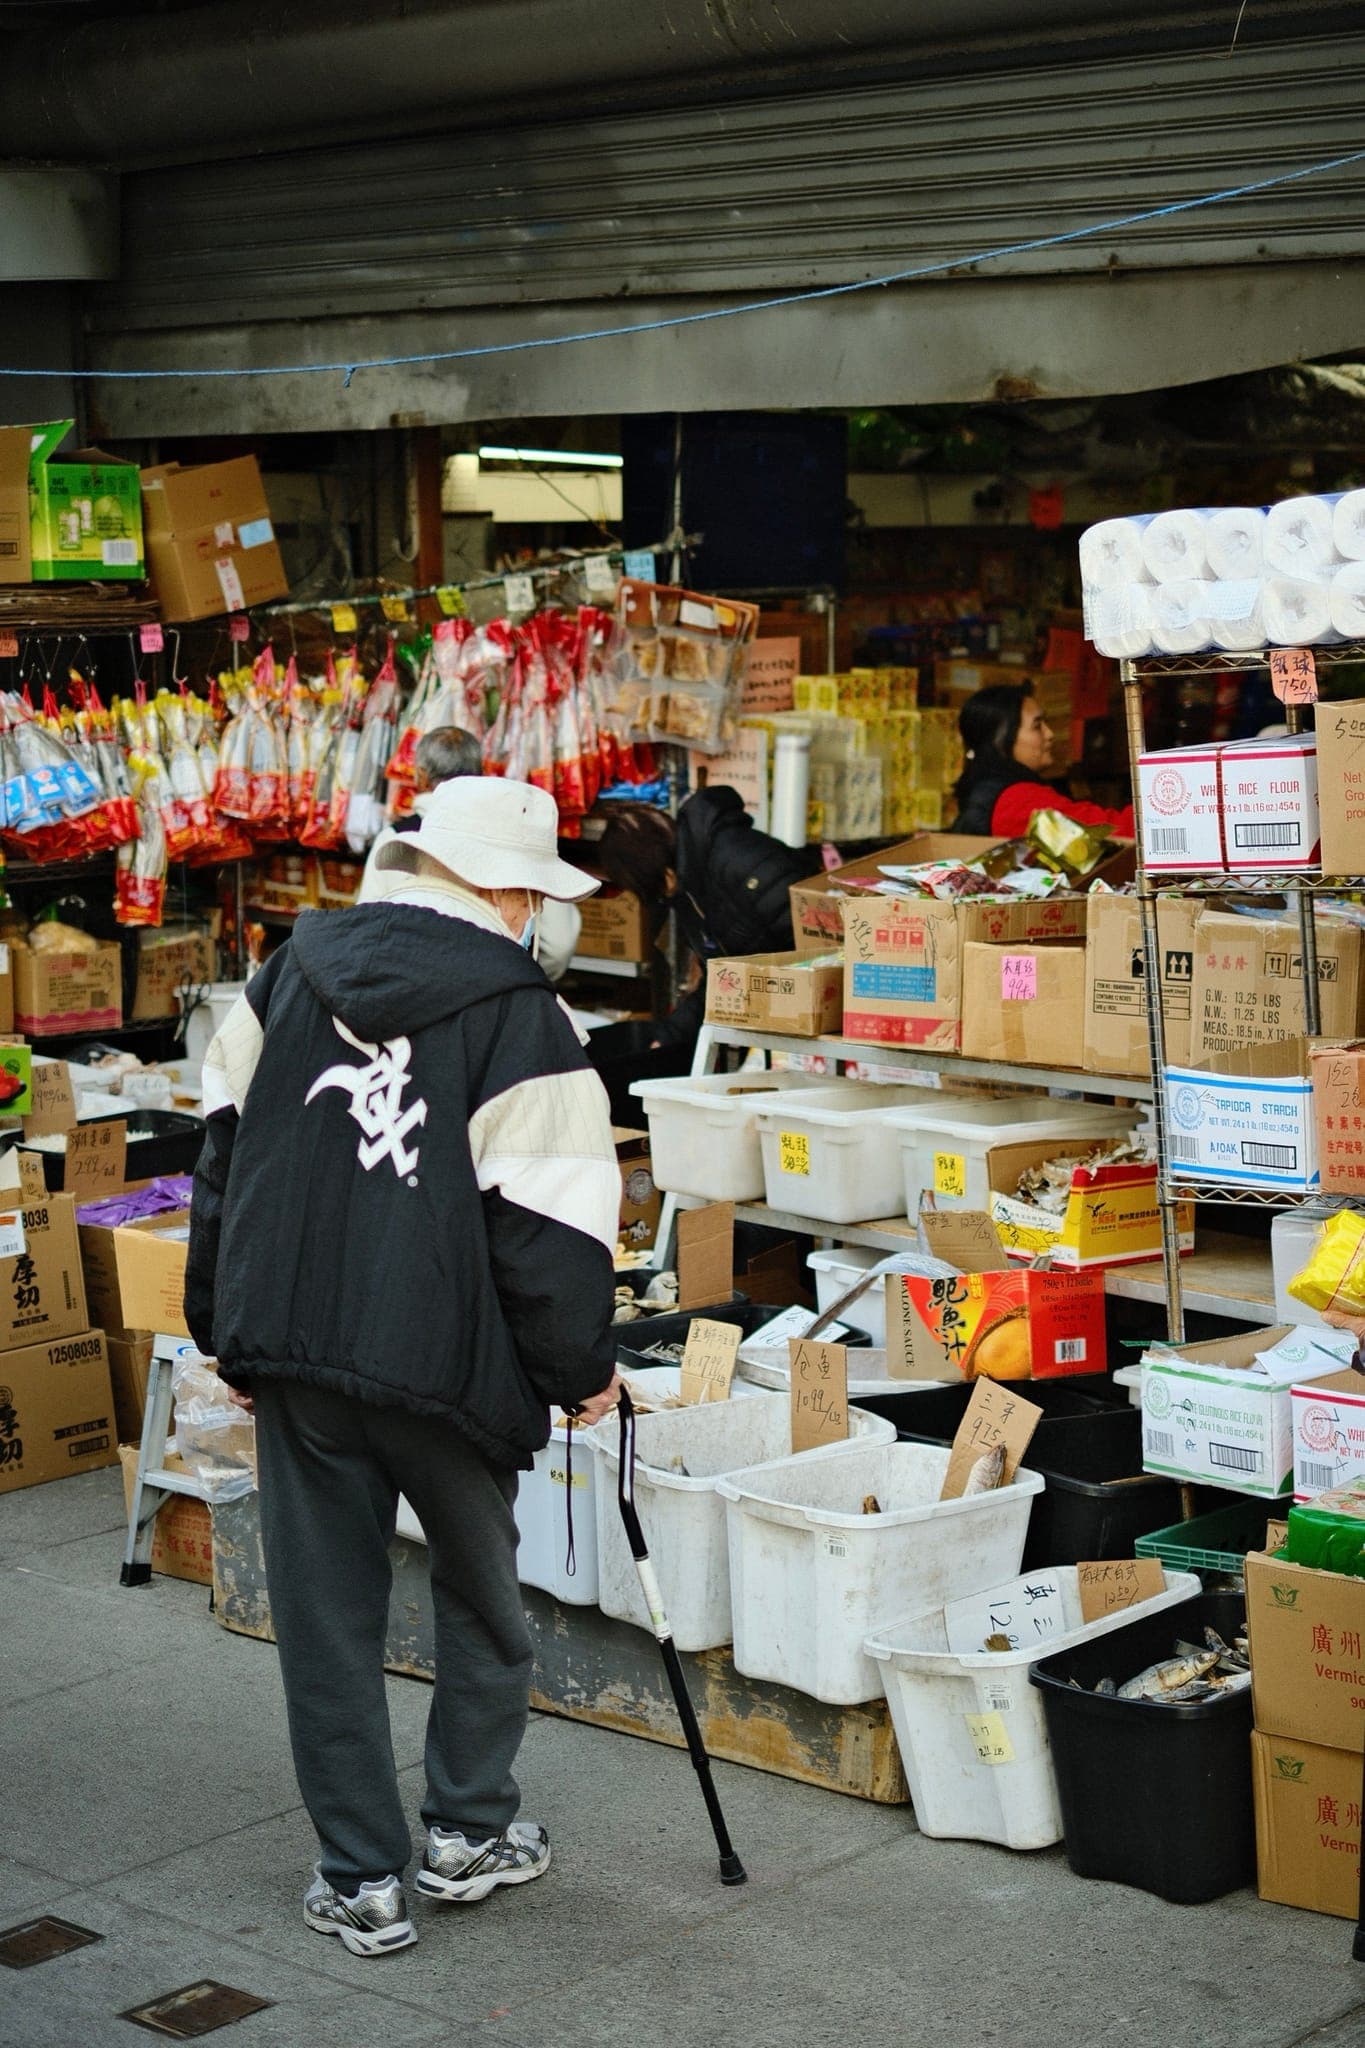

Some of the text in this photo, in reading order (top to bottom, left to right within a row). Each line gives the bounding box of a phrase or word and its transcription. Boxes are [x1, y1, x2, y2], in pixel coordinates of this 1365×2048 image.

[1343, 771, 1362, 784] Net
[1200, 780, 1300, 797] WHE RICE FLOUR
[1193, 805, 1205, 815] NET
[1278, 801, 1294, 811] 454
[1205, 989, 1281, 1008] G.W.: 13.25 LBS
[1204, 1005, 1280, 1024] N.W.: 11.25 LBS
[1203, 1021, 1234, 1037] MEAS.:
[1235, 1025, 1253, 1039] 18.5
[1254, 1027, 1265, 1040] in.
[1267, 1028, 1274, 1040] X
[1276, 1029, 1286, 1040] 13
[1203, 1037, 1243, 1052] PRODUCT
[1215, 1098, 1298, 1118] TAPIOCA STARCH
[1209, 1117, 1218, 1126] NET
[1232, 1119, 1241, 1128] 24
[1280, 1123, 1294, 1134] 454
[901, 1275, 915, 1368] BALONE SAUCE
[48, 1338, 101, 1365] 12508038
[1311, 1624, 1361, 1659] 廣州
